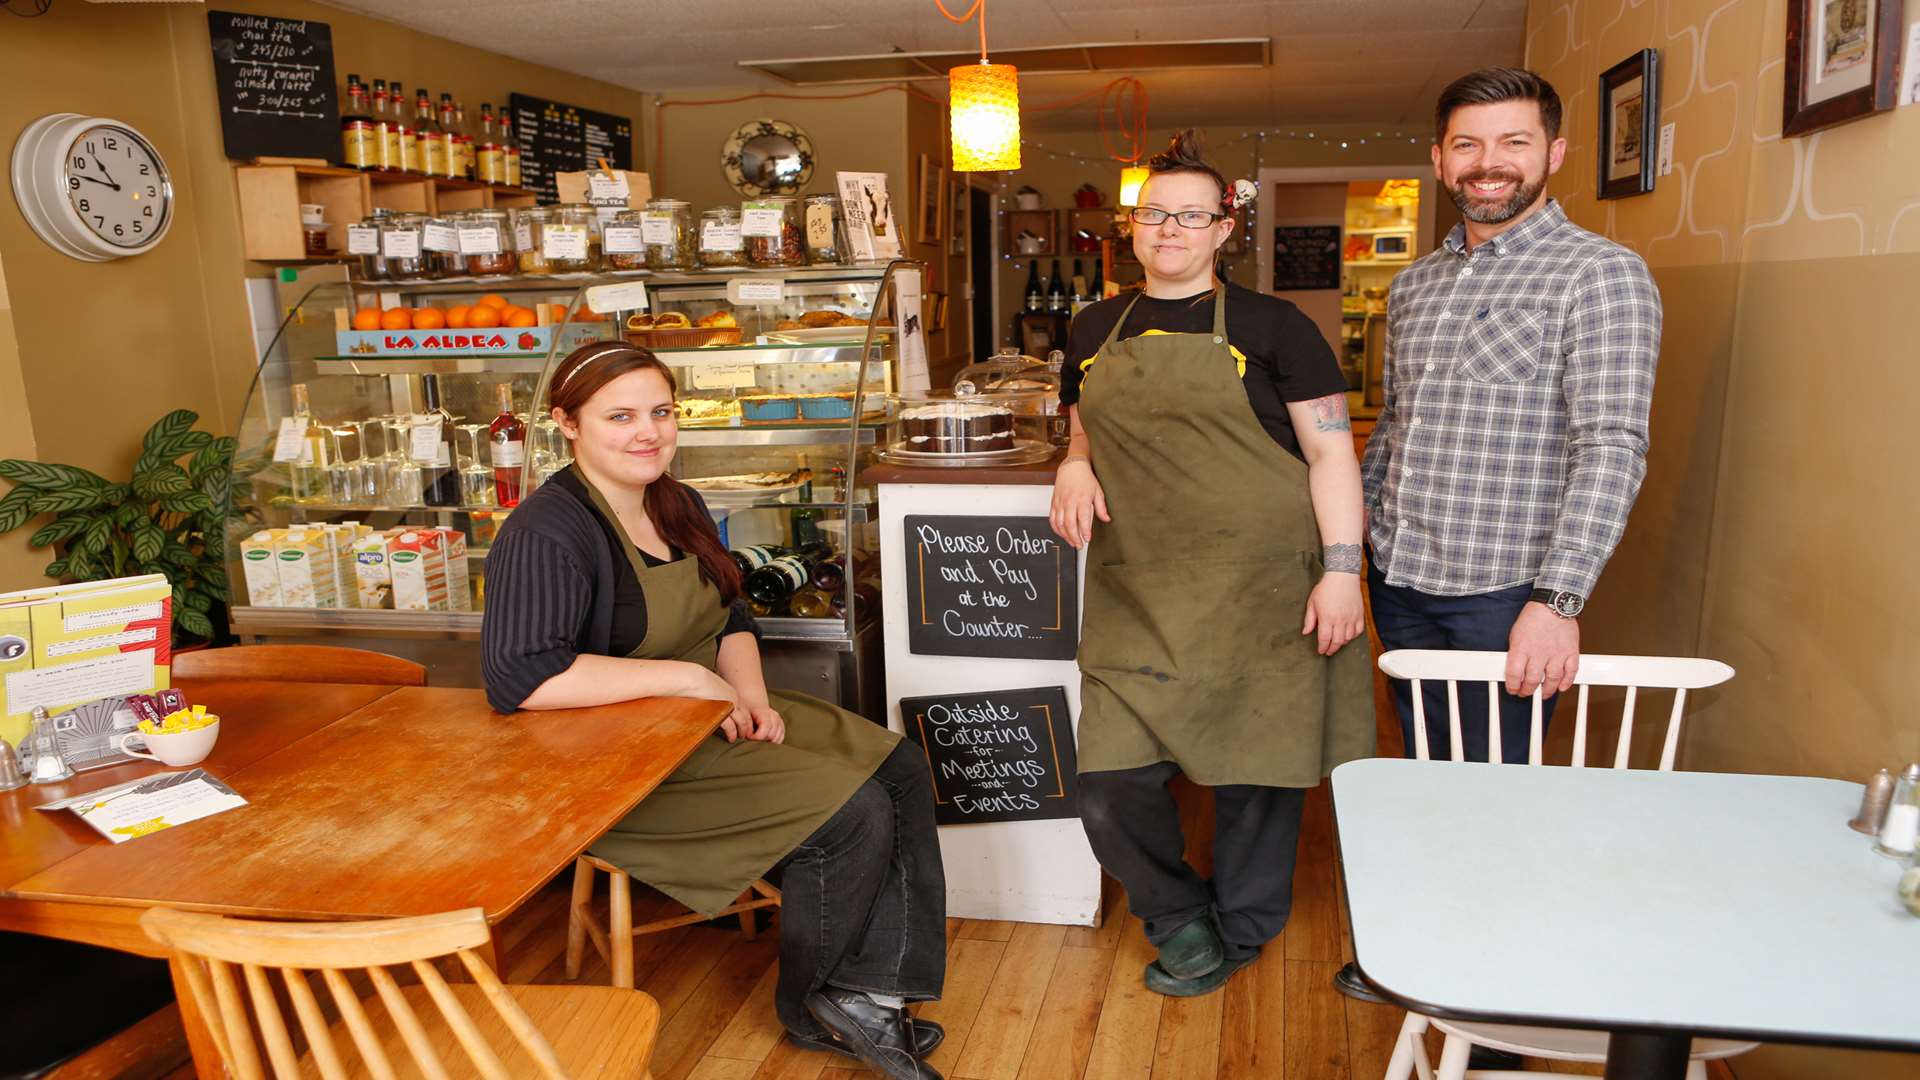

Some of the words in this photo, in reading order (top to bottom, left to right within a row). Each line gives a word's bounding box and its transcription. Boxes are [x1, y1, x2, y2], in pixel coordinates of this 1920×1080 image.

[231, 17, 269, 30] Mulled
[103, 137, 117, 150] 12
[73, 156, 86, 169] 10
[139, 164, 149, 175] 2
[69, 178, 80, 190] 9
[146, 185, 156, 197] 3
[79, 199, 90, 212] 8
[93, 215, 104, 229] 7
[132, 220, 143, 233] 5
[113, 224, 124, 236] 6
[384, 335, 416, 349] LA
[422, 335, 509, 350] ALDEA
[917, 524, 989, 554] Please
[996, 527, 1054, 555] Order
[360, 552, 382, 562] alpro
[940, 560, 984, 583] and
[989, 558, 1037, 600] Pay
[958, 590, 978, 606] at
[982, 591, 1010, 607] the
[927, 700, 1019, 725] Outside
[934, 724, 1038, 753] Catering
[941, 759, 1045, 788] Meetings
[953, 790, 1040, 814] Events
